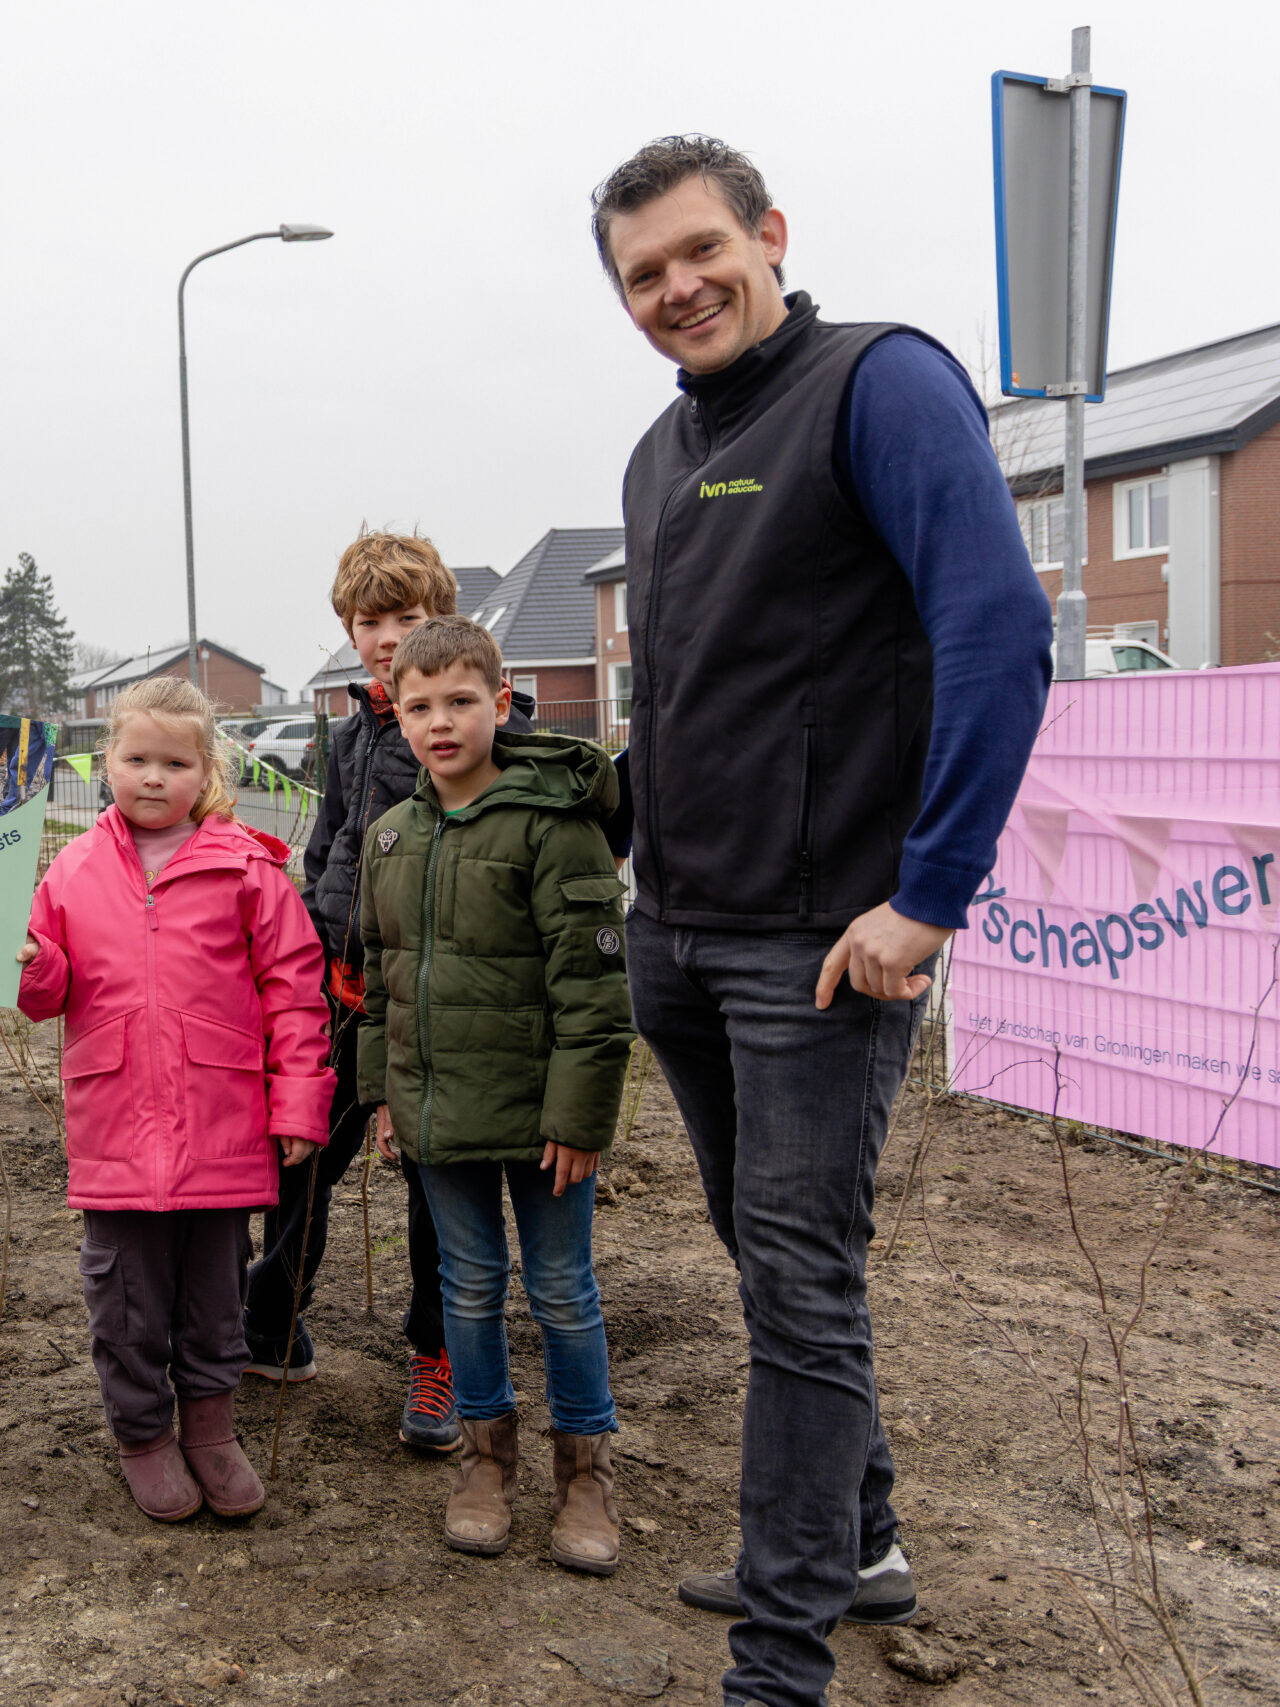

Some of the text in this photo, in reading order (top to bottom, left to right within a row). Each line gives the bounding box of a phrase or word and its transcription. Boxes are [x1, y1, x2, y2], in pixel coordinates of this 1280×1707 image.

[727, 484, 763, 494] educatie
[728, 478, 755, 487] natuur
[700, 481, 727, 498] ivn
[969, 1012, 992, 1031] Het
[996, 1017, 1061, 1045] landschap
[1065, 1033, 1089, 1049] van
[1094, 1035, 1171, 1065] Groningen
[1177, 1052, 1231, 1075] maken
[1236, 1064, 1261, 1080] we
